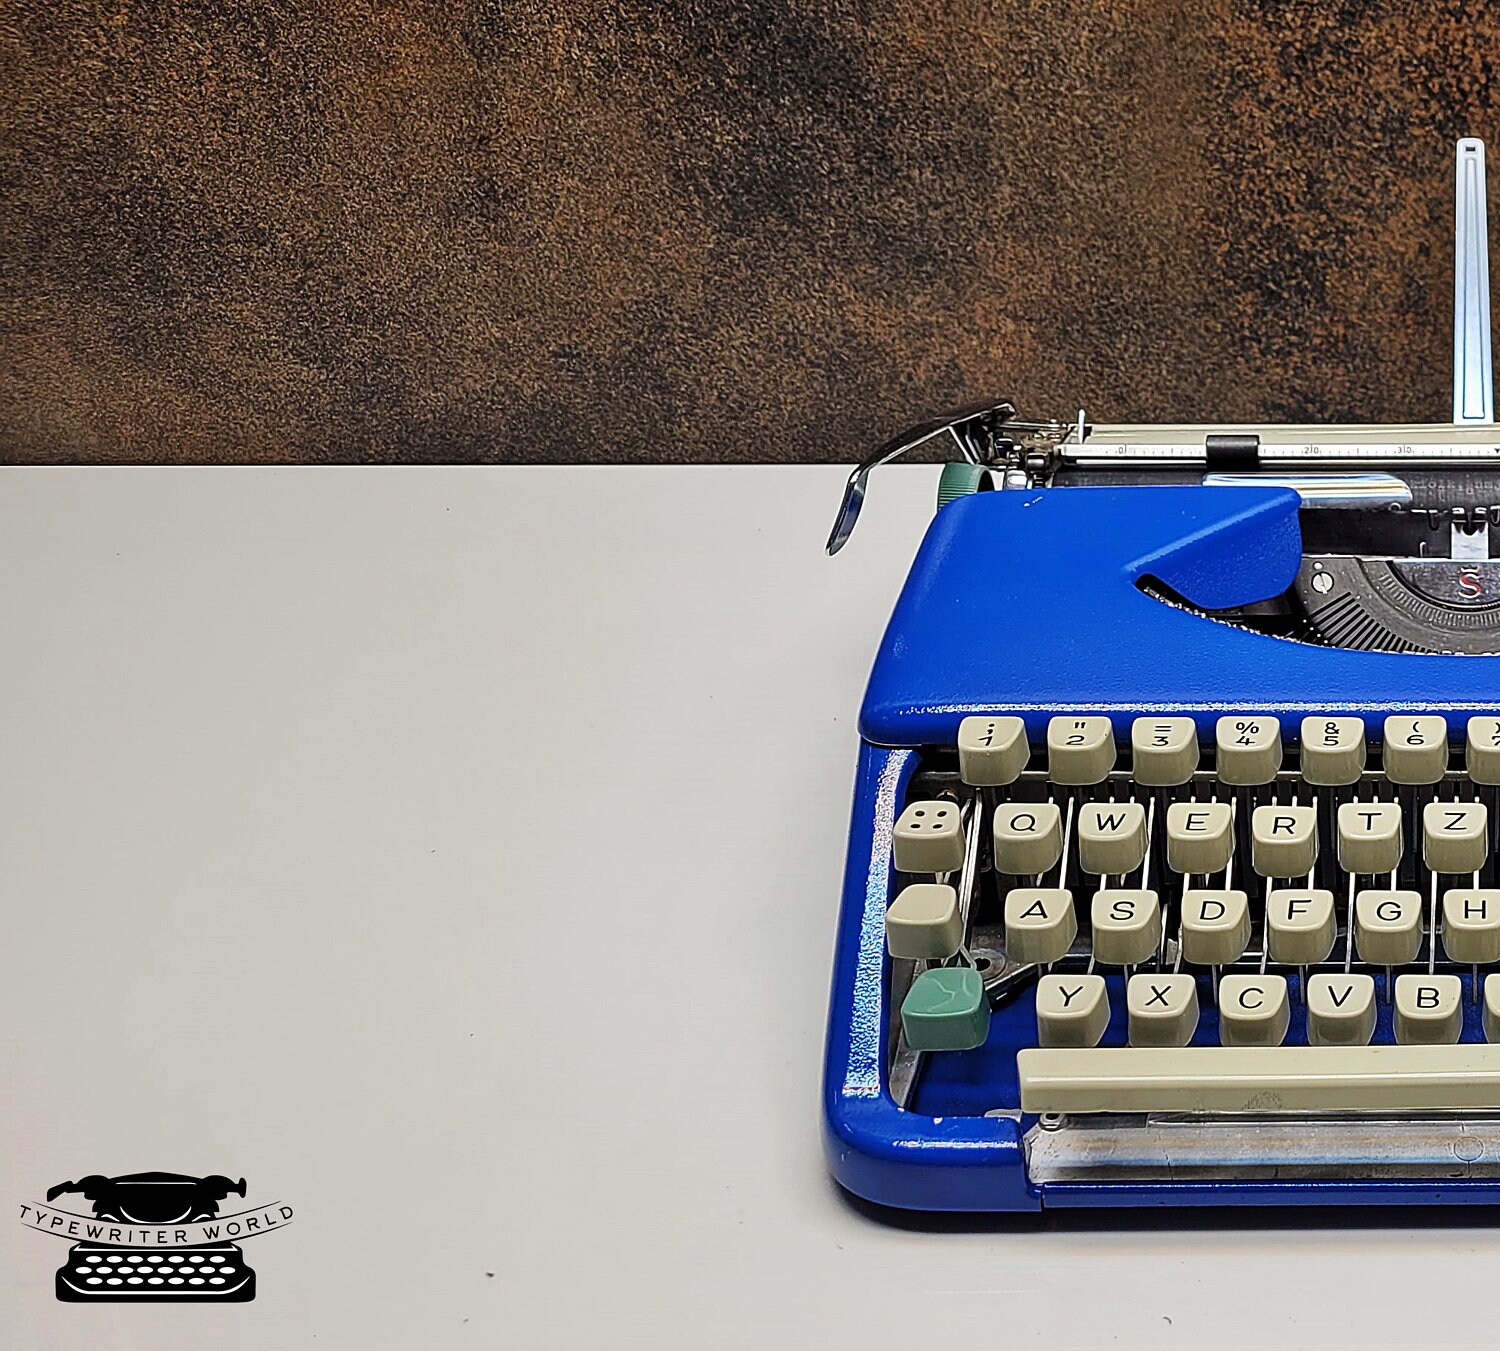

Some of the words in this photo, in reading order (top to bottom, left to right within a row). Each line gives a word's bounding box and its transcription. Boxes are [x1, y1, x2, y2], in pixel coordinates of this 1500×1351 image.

[1304, 446, 1320, 455] 20
[1397, 446, 1412, 455] 30
[1235, 721, 1260, 735] %
[1324, 721, 1340, 735] &
[978, 735, 993, 747] 1
[1065, 734, 1085, 746] 2
[1151, 735, 1169, 747] 3
[1235, 735, 1256, 746] 4
[1323, 735, 1339, 747] 5
[1406, 734, 1425, 746] 6
[1009, 813, 1036, 832] Q
[1096, 813, 1126, 831] W
[1185, 812, 1210, 831] E
[1272, 816, 1296, 835] R
[1357, 812, 1382, 831] T
[1443, 812, 1467, 831] Z
[1019, 900, 1048, 919] A
[1109, 901, 1135, 921] S
[1199, 900, 1226, 921] D
[1287, 899, 1312, 921] F
[1376, 901, 1402, 922] G
[1464, 899, 1487, 920] H
[1058, 985, 1084, 1007] Y
[1144, 985, 1172, 1007] X
[1238, 987, 1264, 1009] C
[1327, 985, 1353, 1008] V
[1416, 987, 1440, 1009] B
